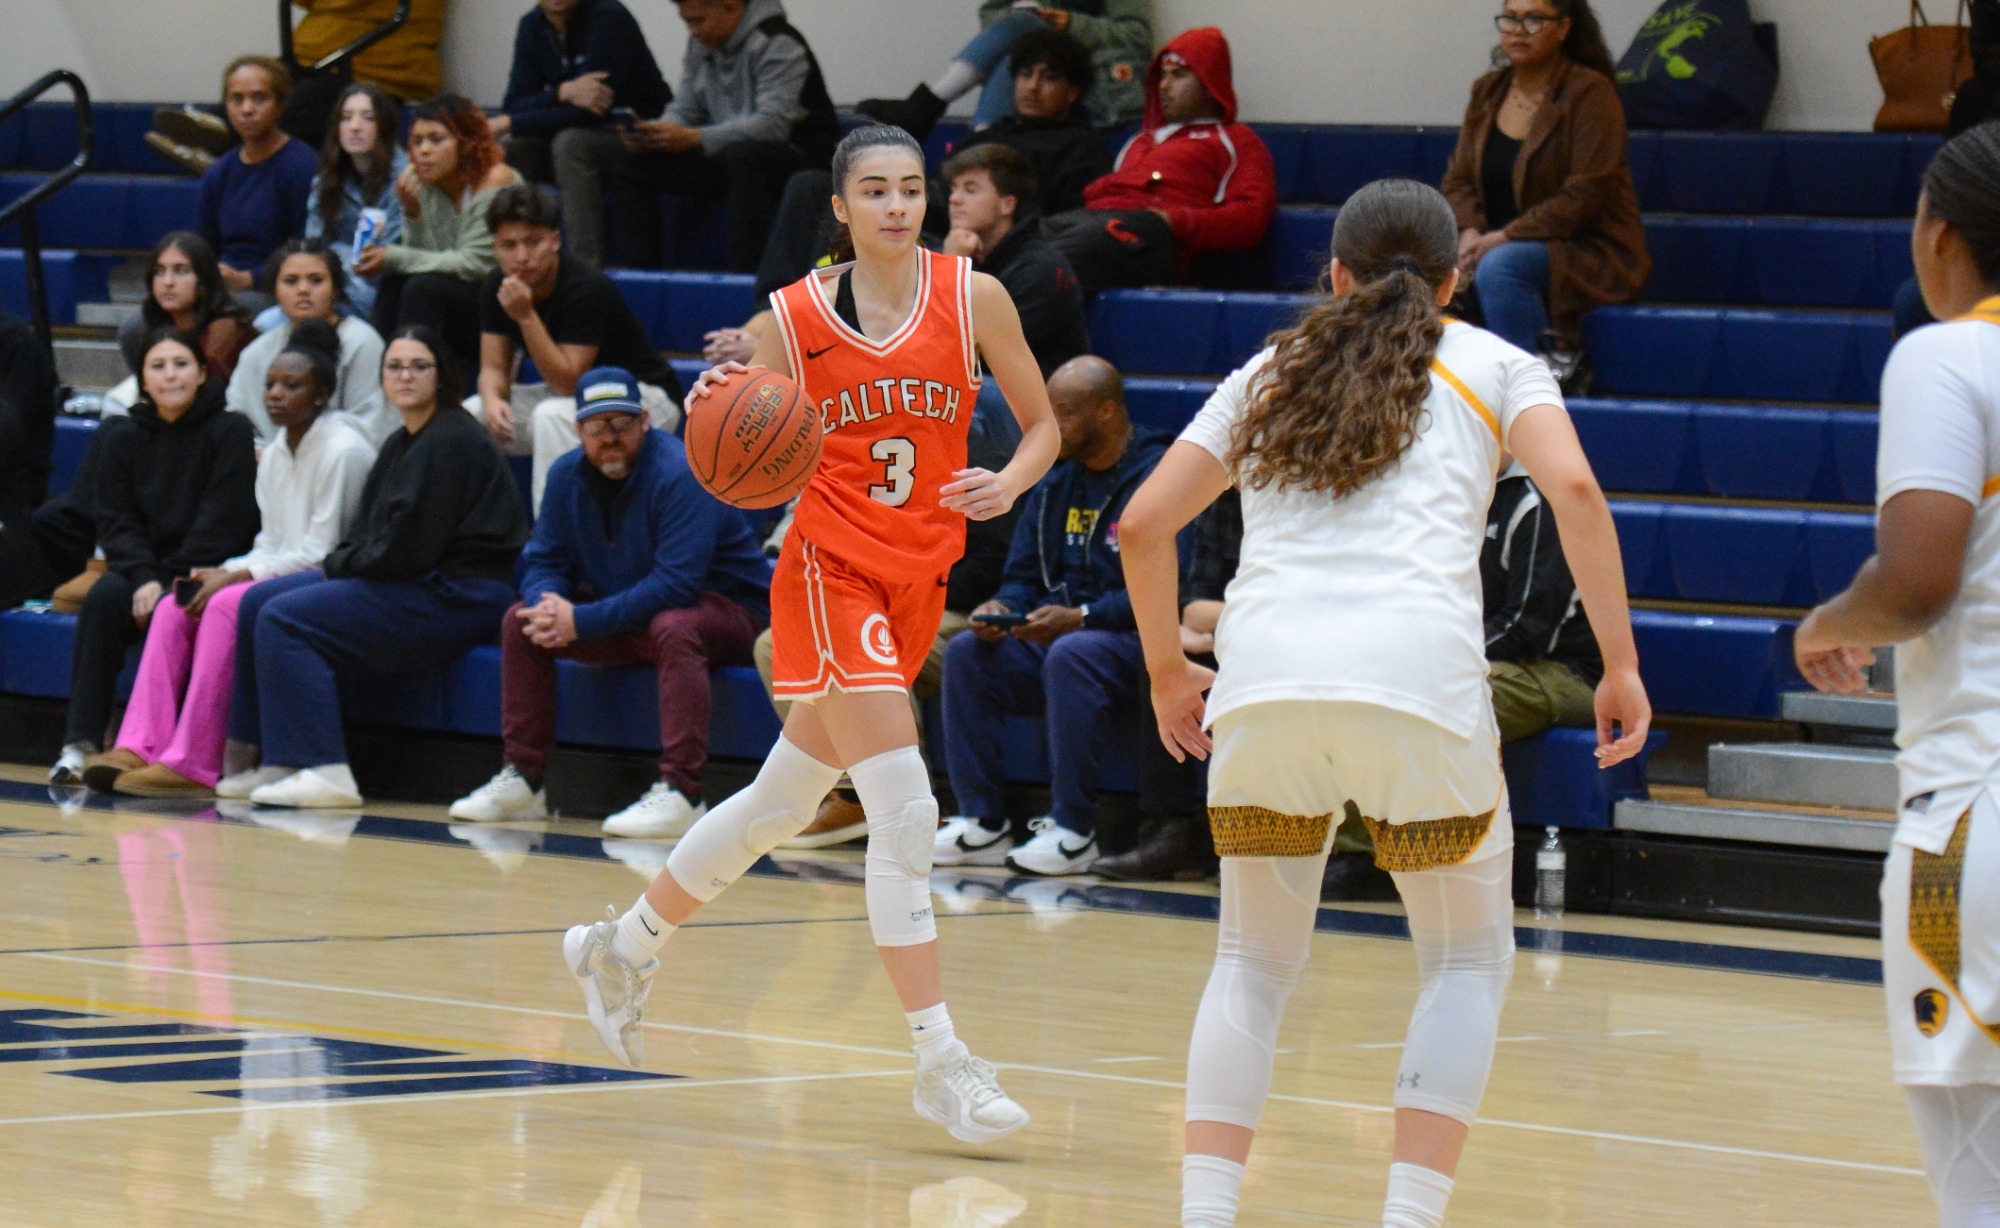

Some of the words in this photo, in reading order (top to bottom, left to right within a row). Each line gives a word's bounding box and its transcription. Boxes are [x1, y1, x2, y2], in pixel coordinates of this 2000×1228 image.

[741, 385, 788, 454] LEGACY
[761, 401, 817, 480] SPALDING
[821, 377, 960, 435] CALTECH
[868, 436, 916, 508] 3
